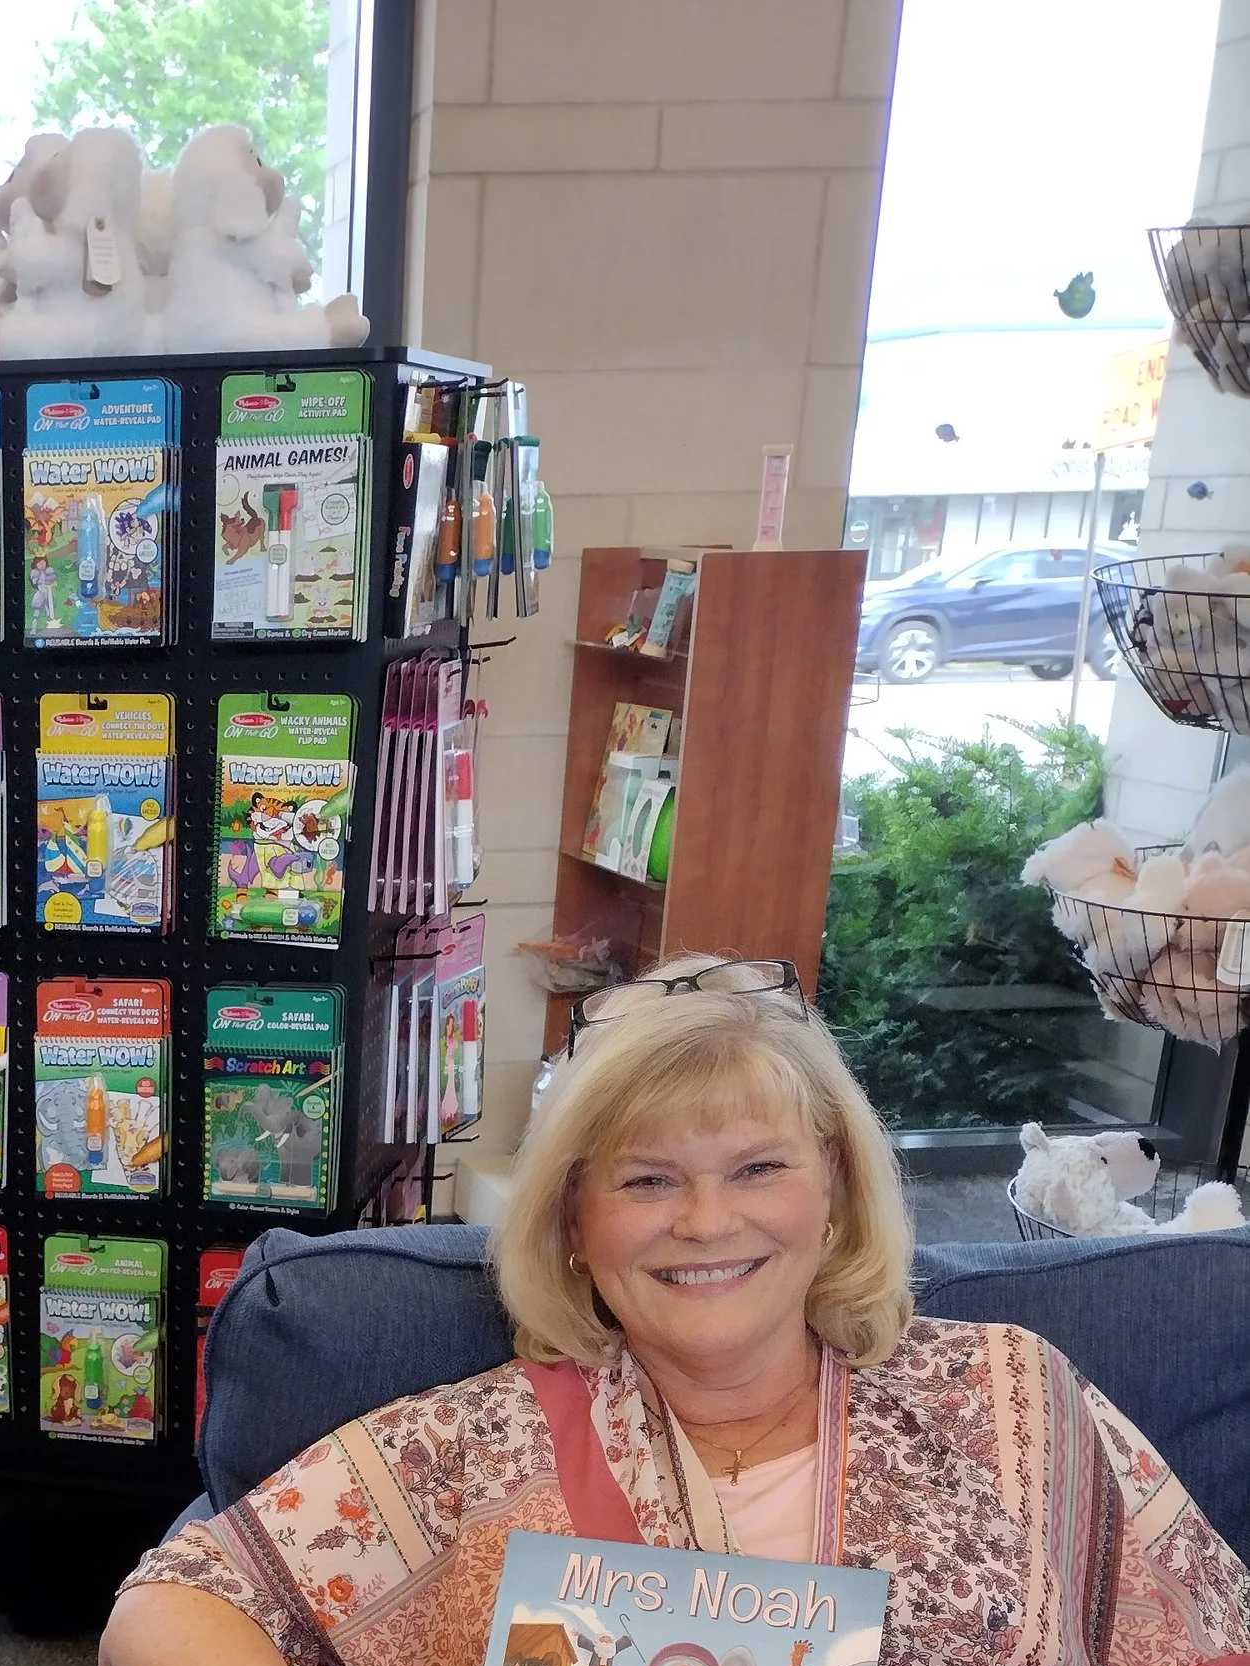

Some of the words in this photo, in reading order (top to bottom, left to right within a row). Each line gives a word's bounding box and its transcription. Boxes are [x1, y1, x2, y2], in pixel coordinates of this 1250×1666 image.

[301, 396, 346, 408] WIPE-OFF
[101, 403, 154, 415] ADVENTURE
[298, 410, 330, 418] ACTIVITY
[331, 409, 347, 417] PAD
[146, 416, 162, 424] PAD
[227, 410, 248, 424] ON
[264, 408, 285, 422] GO
[33, 418, 52, 432] ON
[70, 416, 90, 431] GO
[224, 452, 282, 471] ANIMAL
[288, 446, 348, 466] GAMES!
[29, 460, 92, 486] Water
[94, 456, 156, 485] WOW!
[114, 712, 152, 720] VEHICLES
[280, 716, 310, 726] WACKY
[312, 717, 348, 727] ANIMALS
[102, 722, 133, 730] CONNECT
[224, 726, 243, 738] ON
[259, 726, 279, 739] GO
[298, 737, 313, 745] FLIP
[313, 737, 328, 745] PAD
[42, 762, 100, 786] Water
[101, 762, 160, 788] WOW!
[230, 762, 283, 786] Water
[285, 762, 342, 786] WOW!
[112, 998, 142, 1007] SAFARI
[43, 1010, 60, 1022] ON
[76, 1010, 95, 1023] GO
[282, 1012, 314, 1022] SAFARI
[212, 1018, 231, 1030] ON
[245, 1018, 265, 1031] GO
[315, 1023, 330, 1031] PAD
[40, 1045, 96, 1067] Water
[98, 1045, 155, 1068] WOW!
[226, 1057, 281, 1074] Scratch
[282, 1060, 306, 1075] Art
[46, 1298, 97, 1318] Water
[99, 1302, 150, 1322] WOW!
[558, 1552, 675, 1614] Mrs.
[689, 1568, 838, 1633] Noah
